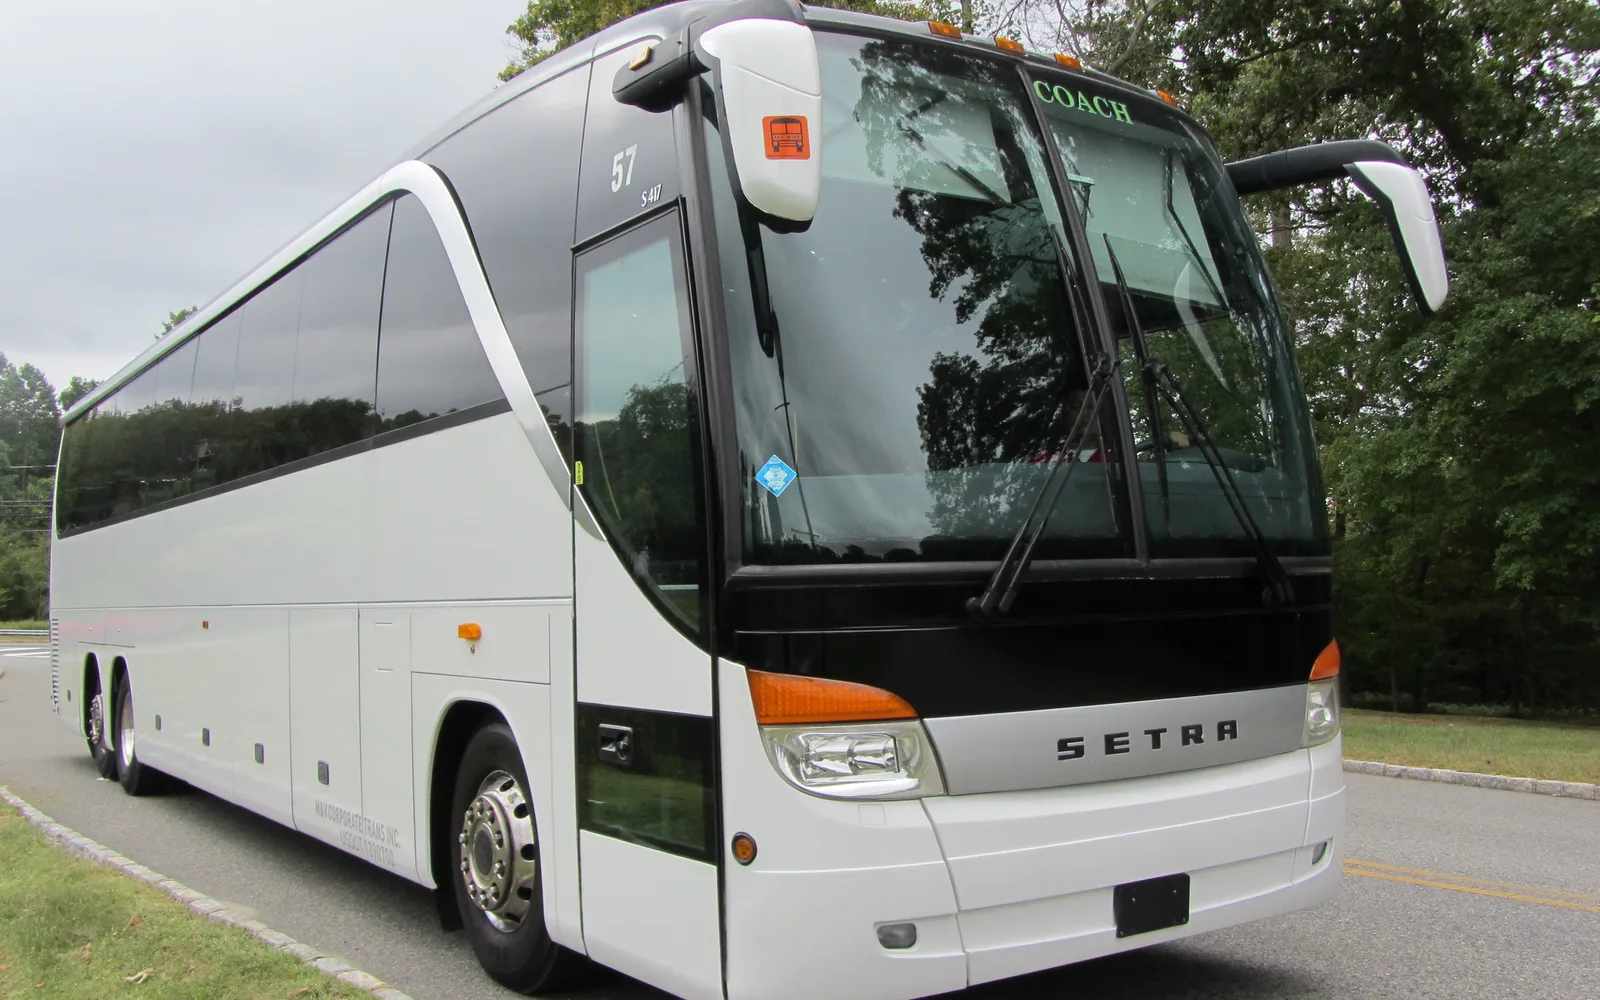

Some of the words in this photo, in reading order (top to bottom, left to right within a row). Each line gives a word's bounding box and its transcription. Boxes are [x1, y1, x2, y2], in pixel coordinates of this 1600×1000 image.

[1033, 80, 1134, 125] COACH
[611, 144, 638, 193] 57
[1057, 720, 1238, 761] SETRA
[328, 803, 363, 834] CORPORATE
[363, 816, 385, 843] TRANS
